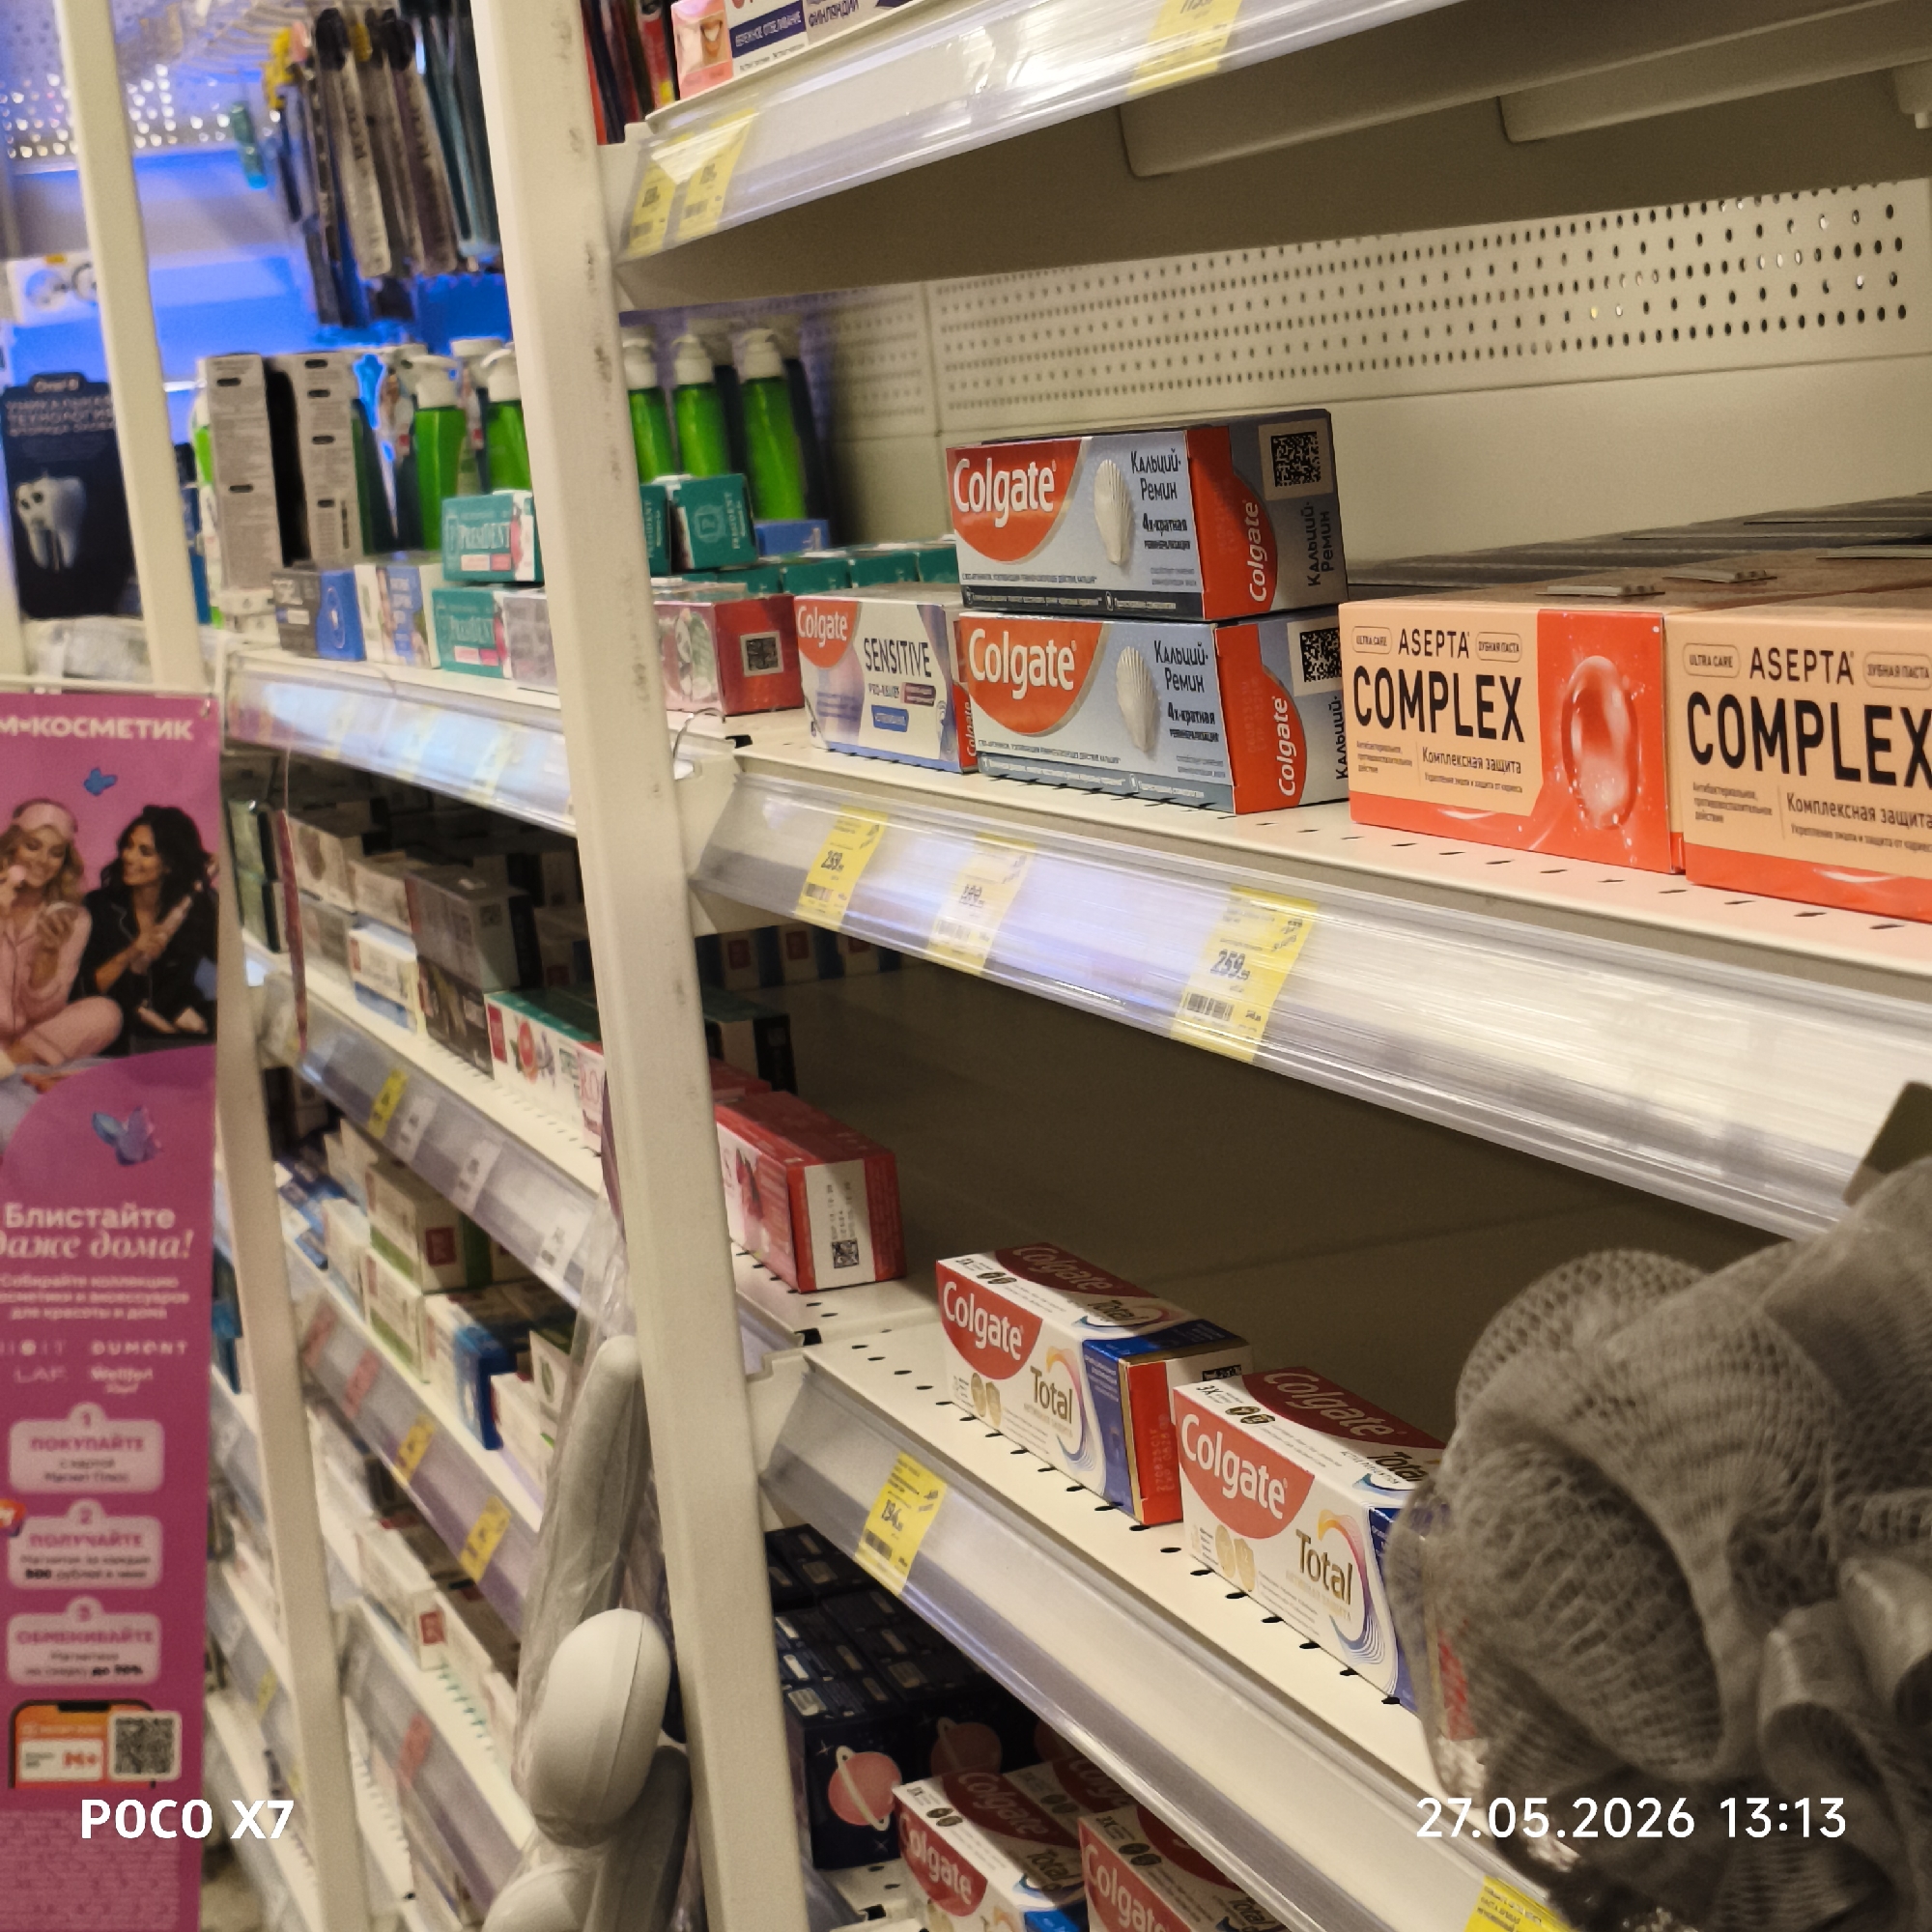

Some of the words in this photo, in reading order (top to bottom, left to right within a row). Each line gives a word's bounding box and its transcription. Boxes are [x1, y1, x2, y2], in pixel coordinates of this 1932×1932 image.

[953, 457, 1055, 528] Colgate
[1140, 478, 1177, 501] Ремин
[1244, 501, 1268, 602] Colgate
[1320, 510, 1334, 573] Ремин
[797, 606, 848, 648] Colgate
[1398, 628, 1469, 659] ASEPTA
[864, 638, 932, 678] SENSITIVE
[969, 628, 1075, 700] Colgate
[1165, 667, 1205, 693] Ремин
[1690, 654, 1712, 667] ULTRA
[1713, 655, 1733, 668] CARE
[1749, 646, 1854, 685] ASEPTA
[1353, 665, 1525, 743] COMPLEX
[1274, 697, 1297, 797] Colgate
[1422, 746, 1484, 770] Комплексная
[1485, 757, 1521, 775] защита
[1687, 691, 1932, 790] COMPLEX
[1787, 791, 1876, 822] Комплексная
[5, 1202, 176, 1229] Блистайте
[90, 1228, 194, 1260] дома!
[1012, 1246, 1113, 1292] Colgate
[943, 1280, 1022, 1361] Colgate
[1030, 1365, 1073, 1424] Total
[1264, 1372, 1394, 1437] Colgate
[1181, 1413, 1286, 1520] Colgate
[1295, 1528, 1353, 1605] Total
[957, 1772, 1049, 1835] Colgate
[901, 1812, 972, 1905] Colgate
